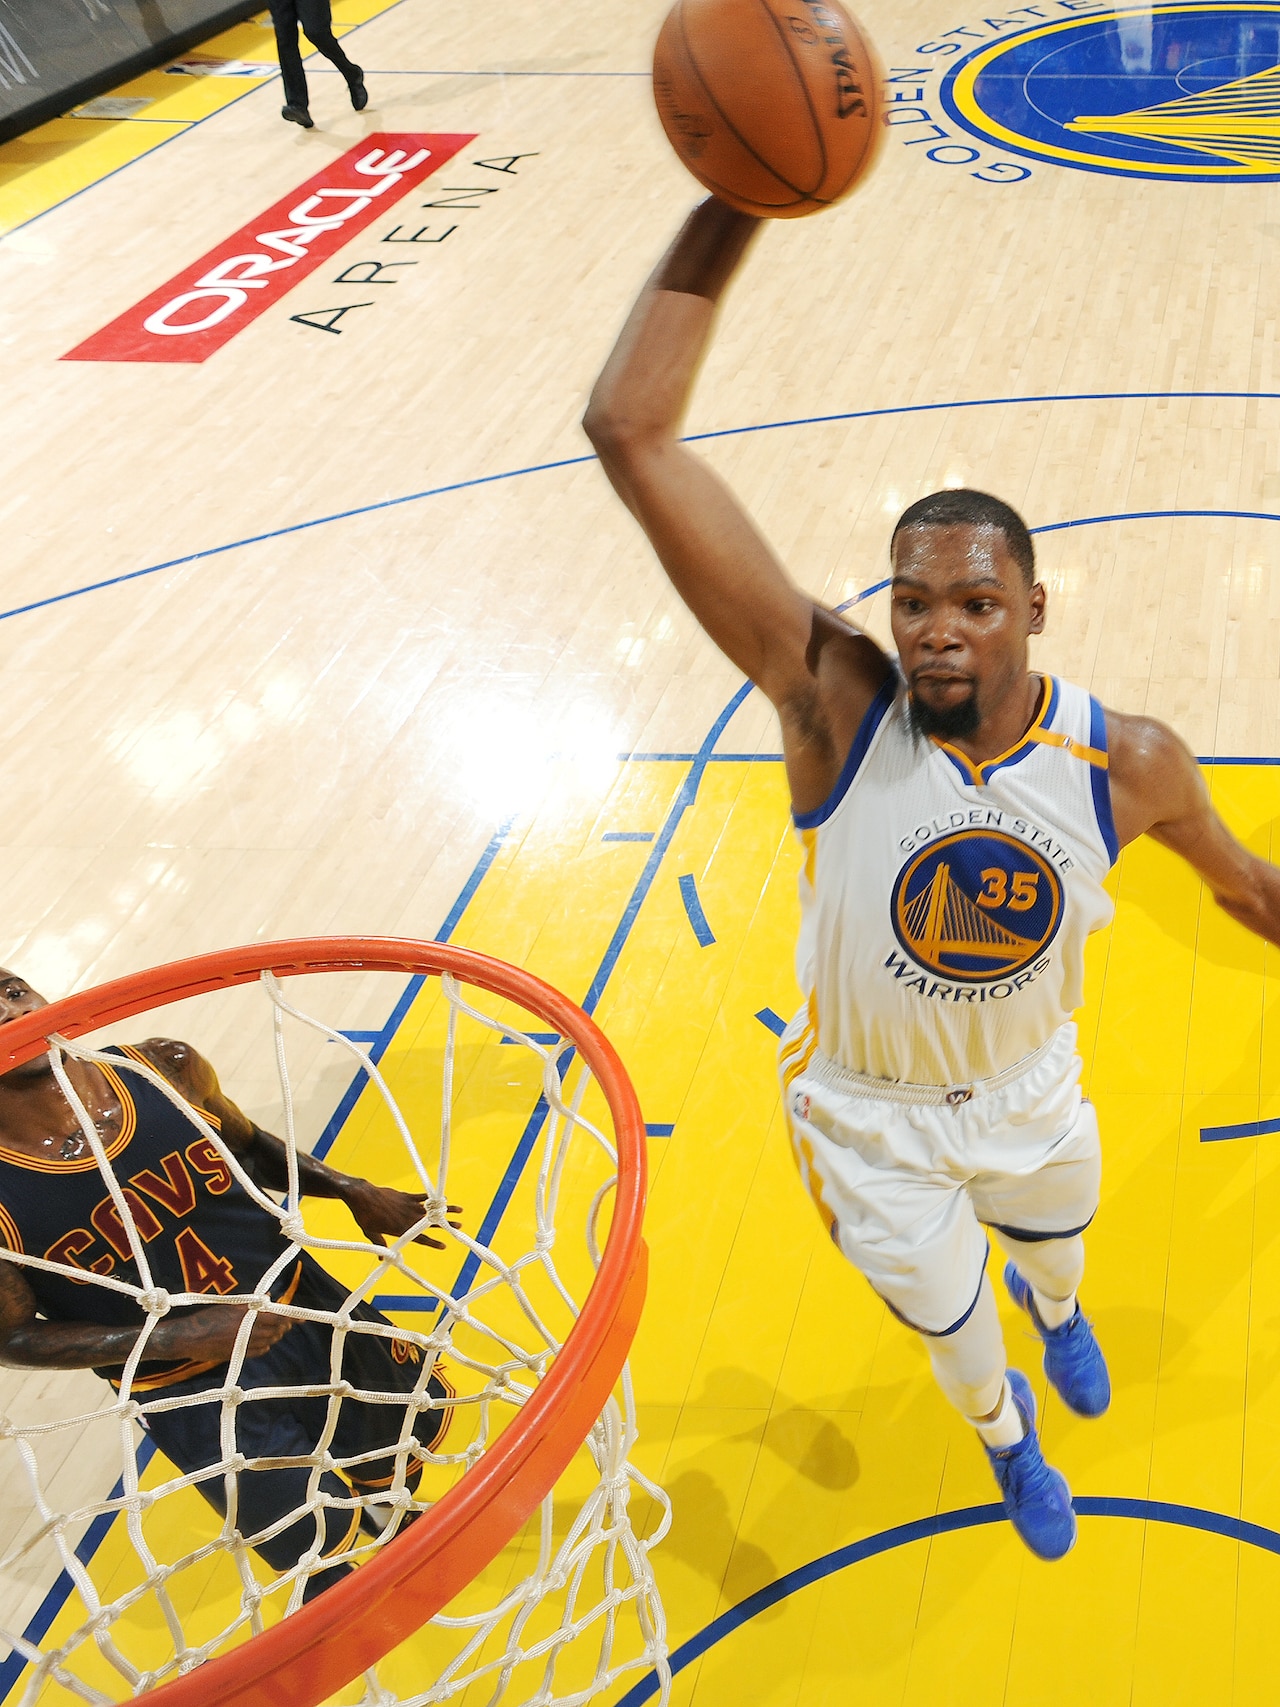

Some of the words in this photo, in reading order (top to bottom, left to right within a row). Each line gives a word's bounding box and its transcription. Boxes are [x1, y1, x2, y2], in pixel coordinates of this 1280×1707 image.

[916, 0, 1104, 55] STATE
[882, 68, 1032, 183] GOLDEN
[143, 148, 432, 336] ORACLE
[289, 152, 540, 335] ARENA
[900, 809, 1004, 853] GOLDEN
[1012, 818, 1075, 875] STATE
[975, 867, 1040, 912] 35
[883, 949, 1051, 1003] WARRIORS
[43, 1137, 232, 1285] CAVS
[174, 1226, 239, 1296] 4
